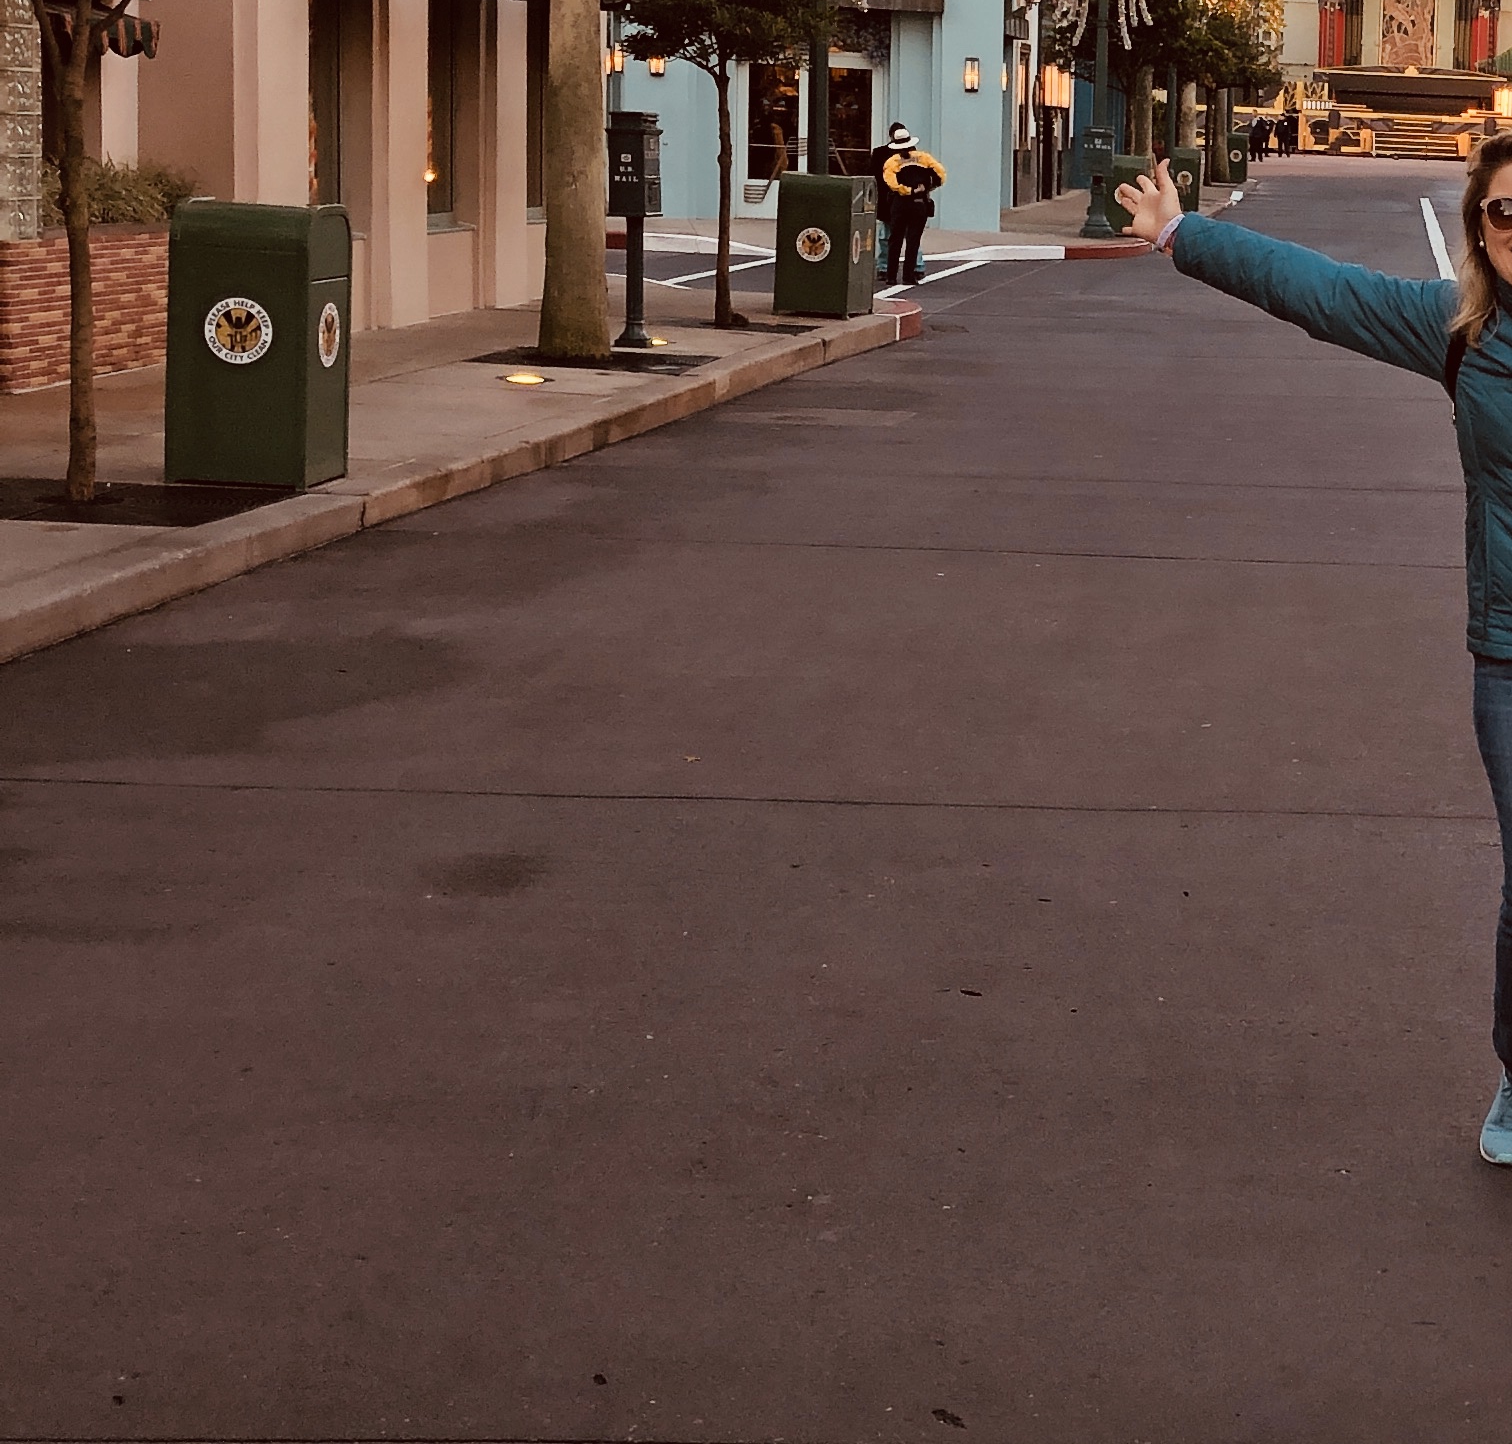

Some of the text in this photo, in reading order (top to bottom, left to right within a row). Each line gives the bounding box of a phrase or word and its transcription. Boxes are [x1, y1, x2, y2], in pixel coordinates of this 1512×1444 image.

[208, 300, 270, 329] PLEASE HELP KEEP
[208, 335, 268, 361] OUR CITY CLEAN
